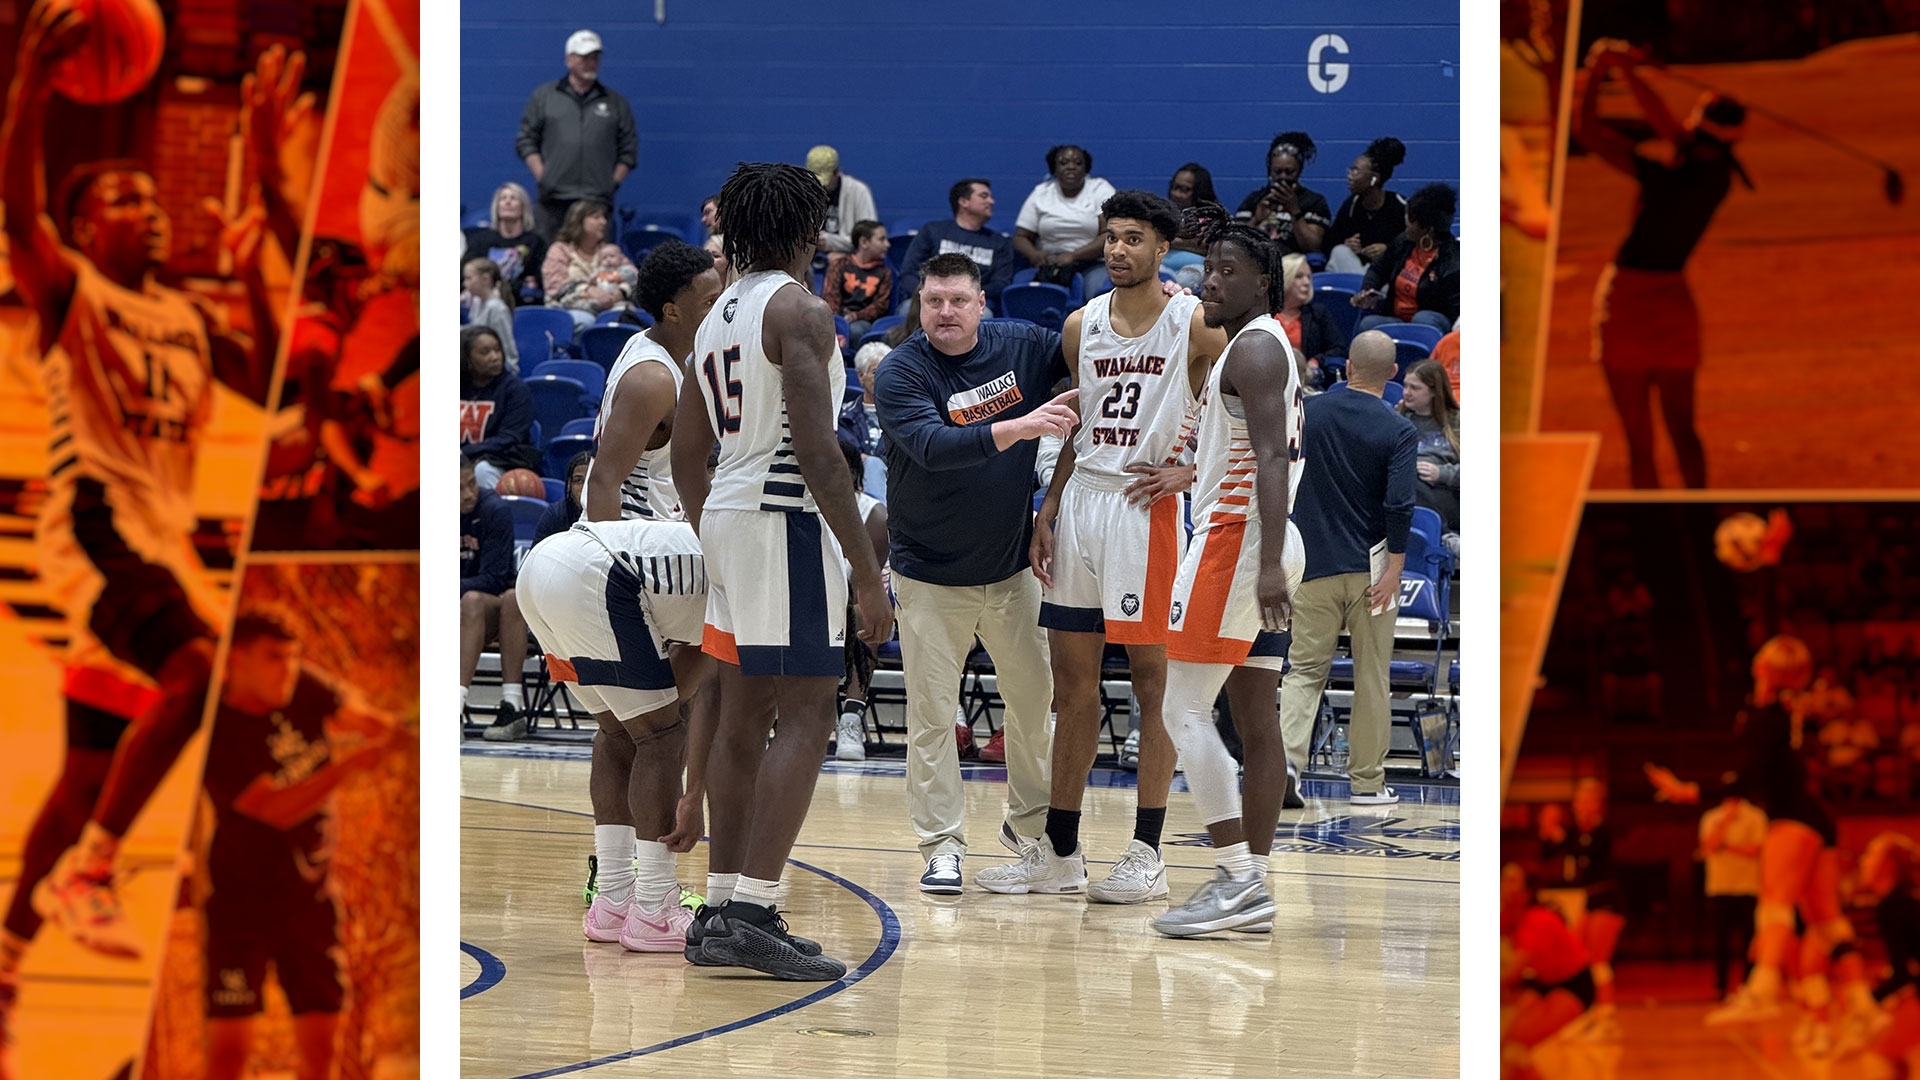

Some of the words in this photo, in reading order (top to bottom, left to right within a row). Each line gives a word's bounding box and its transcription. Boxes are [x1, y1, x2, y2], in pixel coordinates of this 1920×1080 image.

[1308, 34, 1350, 93] G
[1093, 355, 1166, 378] WALLACE
[703, 345, 743, 438] 15
[962, 389, 1020, 422] BASKETBALL
[1102, 381, 1141, 419] 23
[1092, 426, 1140, 448] STATE
